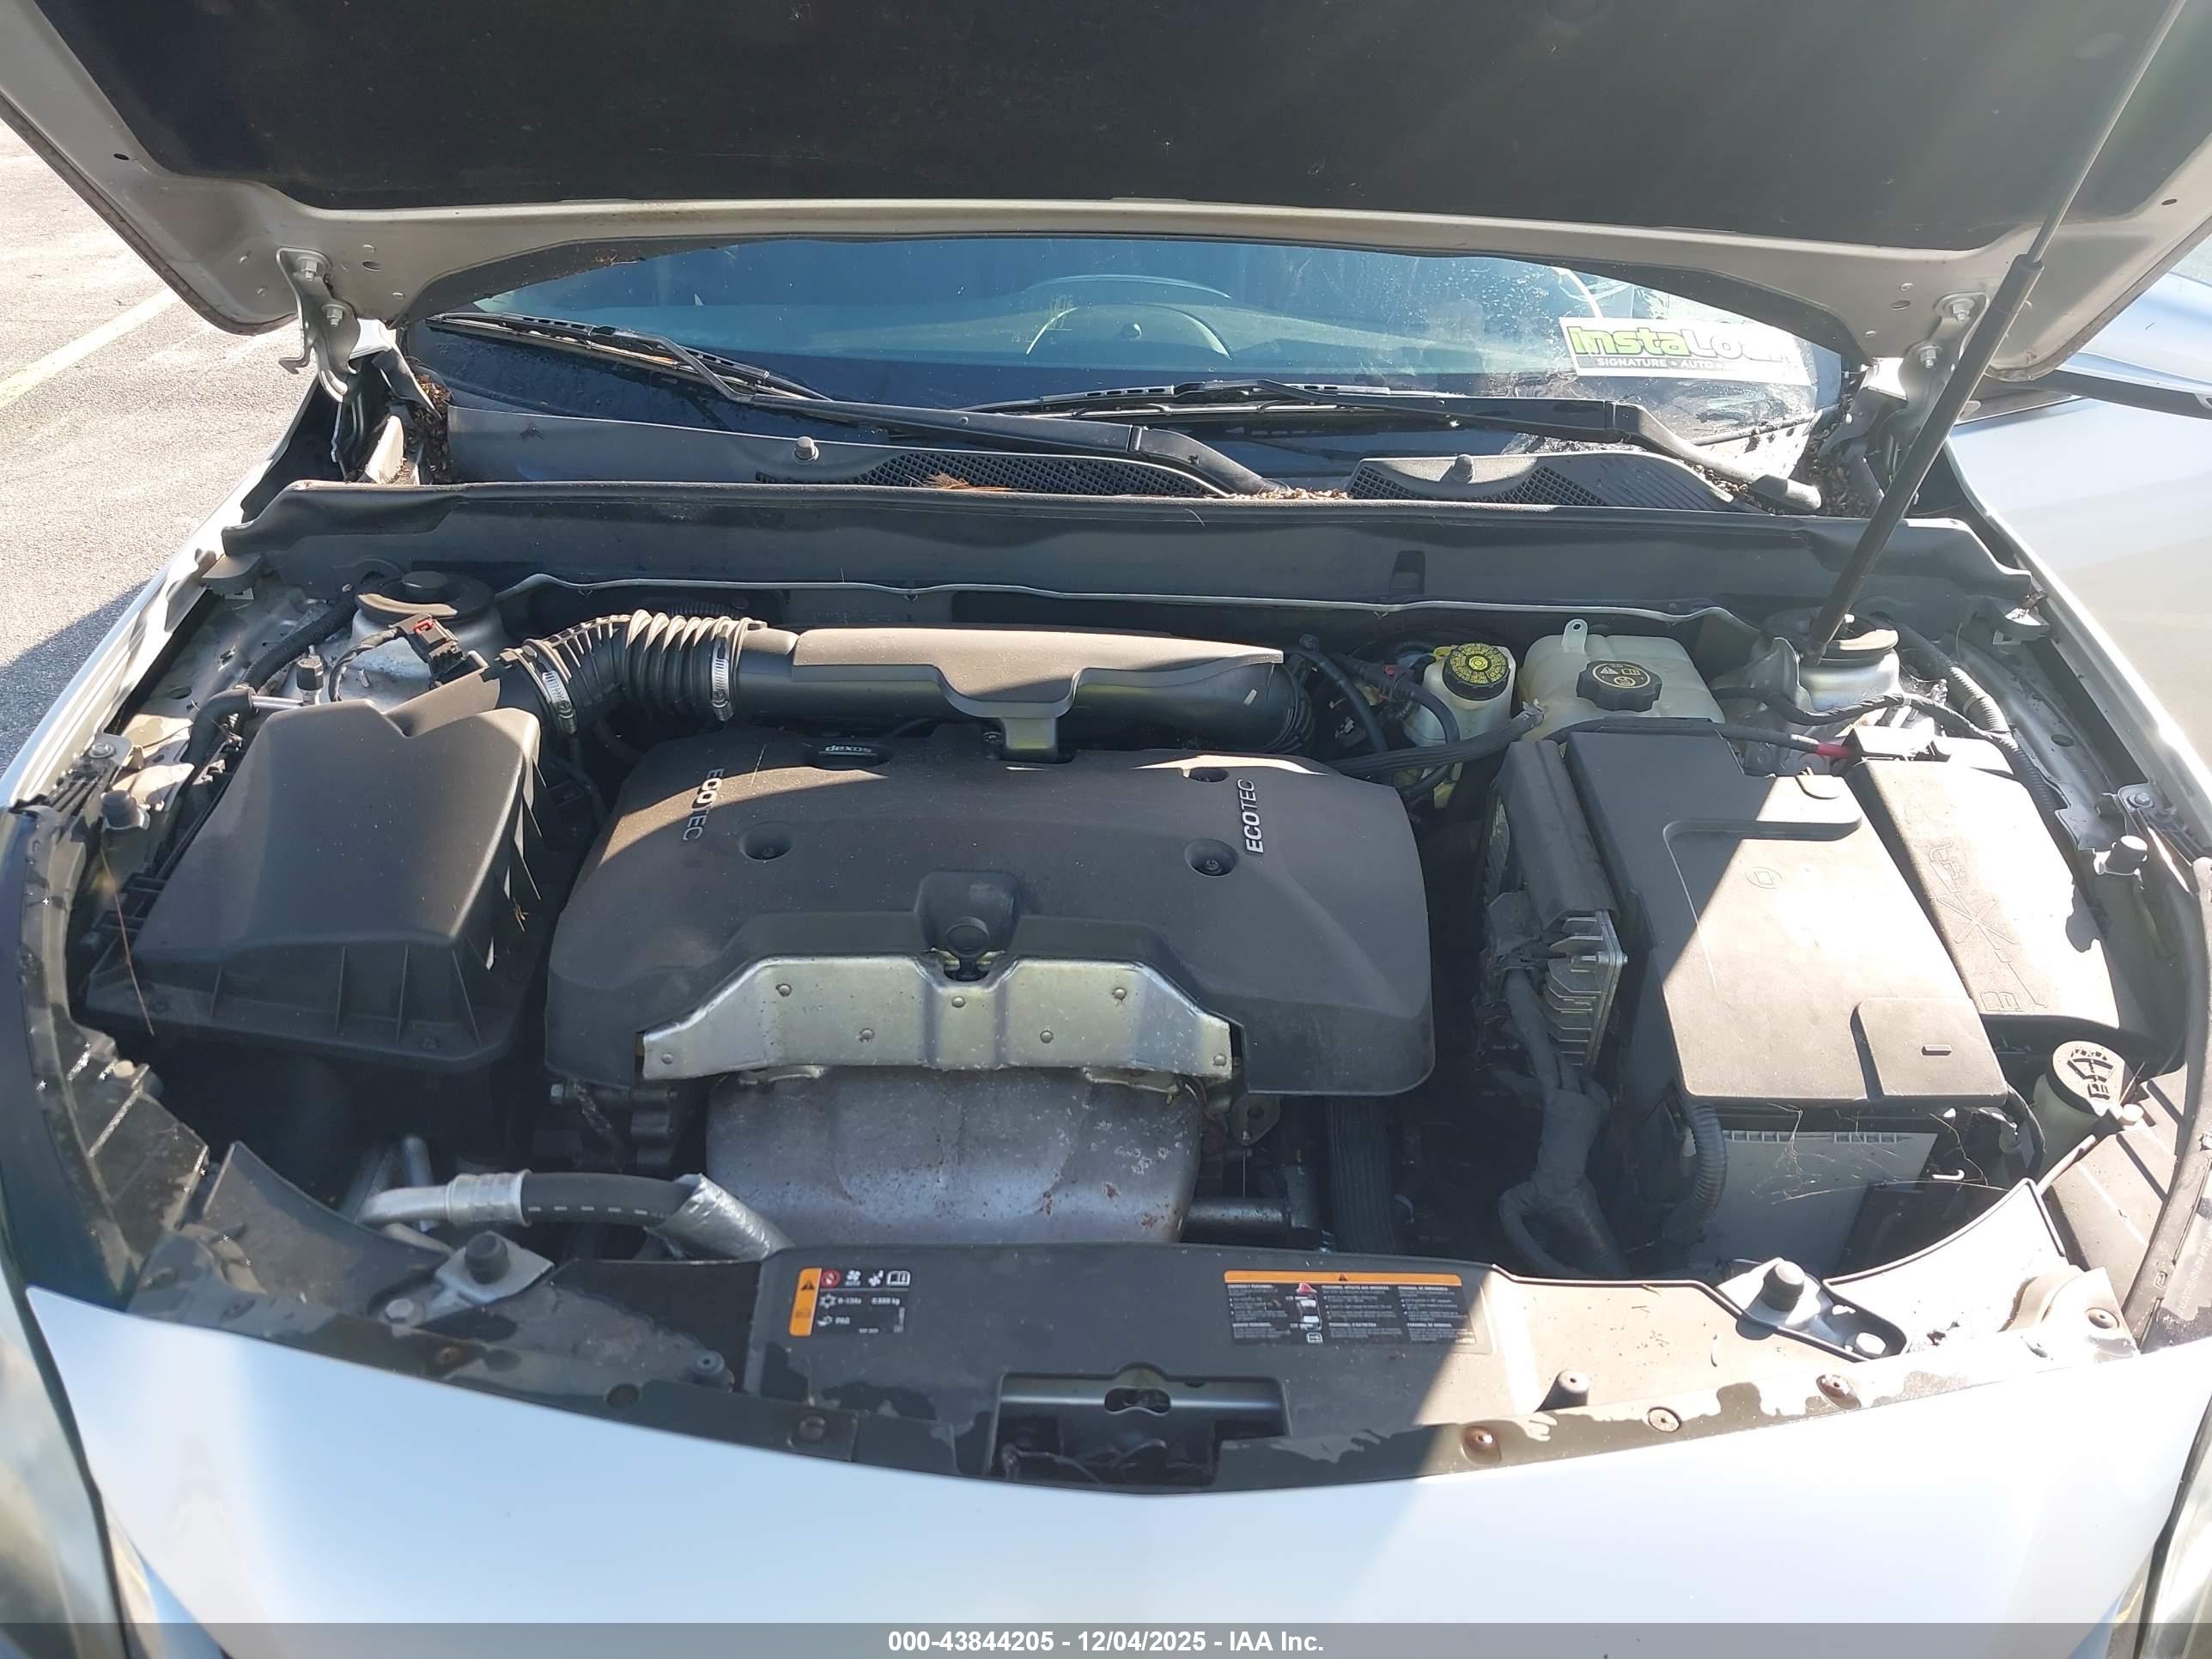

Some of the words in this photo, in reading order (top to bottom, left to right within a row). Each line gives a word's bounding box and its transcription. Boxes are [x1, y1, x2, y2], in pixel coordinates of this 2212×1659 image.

[1596, 357, 1667, 368] SIGNATURE
[1680, 359, 1715, 370] AUTO
[824, 744, 873, 753] dexos
[683, 769, 725, 841] ECOTEC
[1237, 779, 1265, 854] ECOTEC
